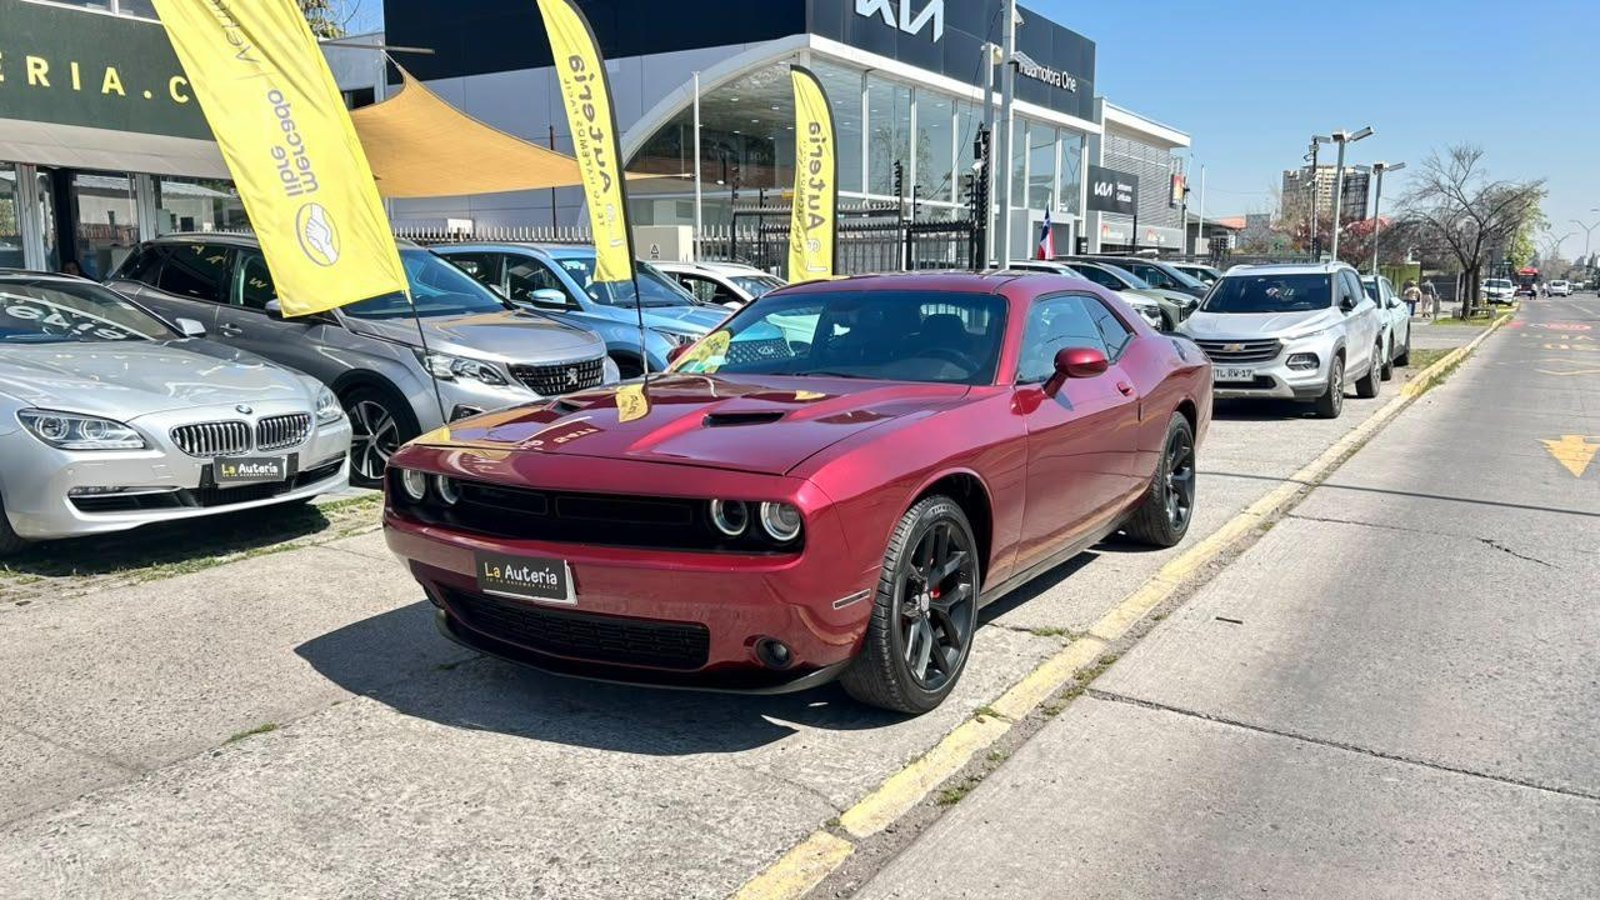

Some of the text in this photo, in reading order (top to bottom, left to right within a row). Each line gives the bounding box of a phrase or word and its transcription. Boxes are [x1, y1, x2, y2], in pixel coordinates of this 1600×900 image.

[0, 51, 189, 103] RIA.C
[1061, 71, 1076, 92] One
[221, 462, 236, 475] La
[484, 561, 501, 578] La
[504, 564, 558, 586] Autería
